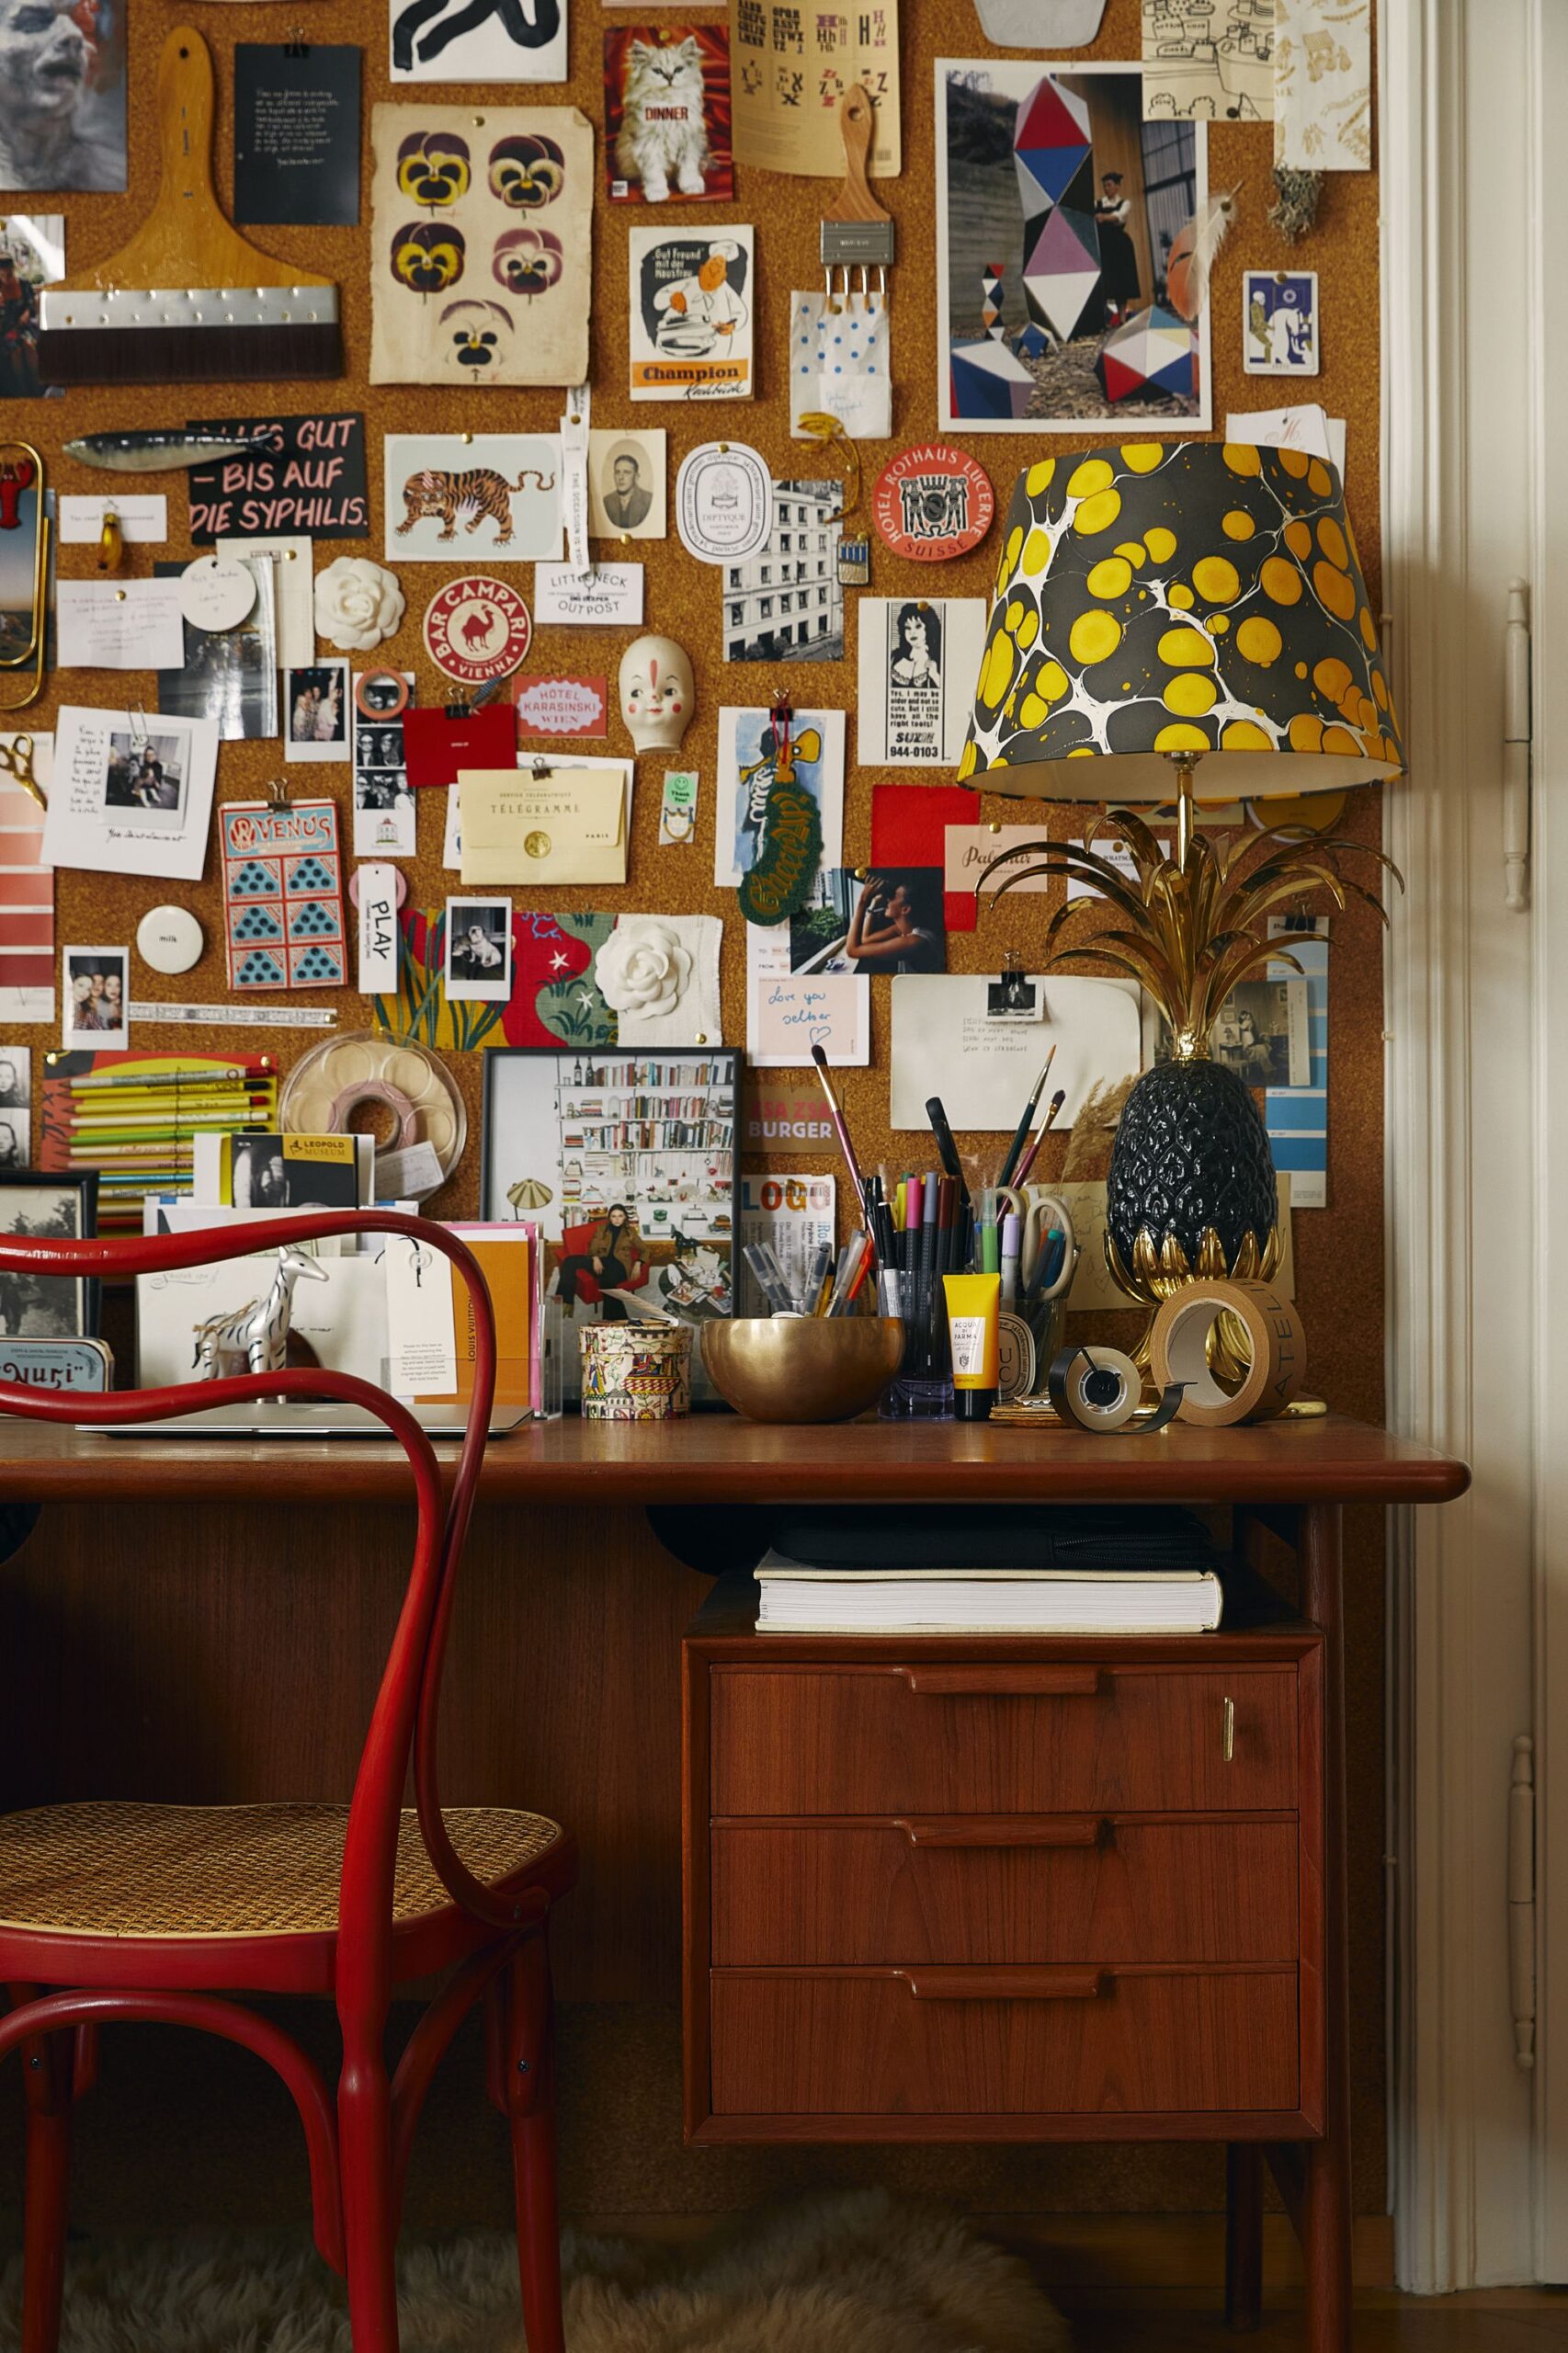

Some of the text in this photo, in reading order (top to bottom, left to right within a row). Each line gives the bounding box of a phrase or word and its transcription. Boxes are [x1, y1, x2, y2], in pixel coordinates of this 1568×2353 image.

[645, 107, 687, 120] DINNER
[643, 365, 739, 383] Champion
[296, 419, 357, 450] GUT
[222, 457, 345, 493] BIS AUF
[878, 447, 992, 543] HOTEL ROTHAUS LUCERNE
[190, 496, 369, 533] DIE SYPHILIS.
[904, 539, 969, 558] SUISSE
[595, 572, 628, 587] NECK
[558, 600, 619, 615] OUTPOST
[430, 580, 527, 659] BAR CAMPARI
[459, 655, 516, 678] VIENNA
[540, 688, 581, 700] HOTEL
[523, 702, 597, 712] KARASINSKI
[891, 746, 938, 757] 944-0103
[491, 803, 581, 813] TÉLÉGRAMME
[252, 812, 332, 847] VENUS
[961, 846, 1031, 868] Palmar
[158, 935, 177, 943] milk
[371, 901, 392, 960] PLAY
[768, 986, 826, 1005] Love you
[749, 1121, 832, 1138] BURGER
[743, 1179, 827, 1211] LOGO
[468, 1335, 476, 1362] LOUIS
